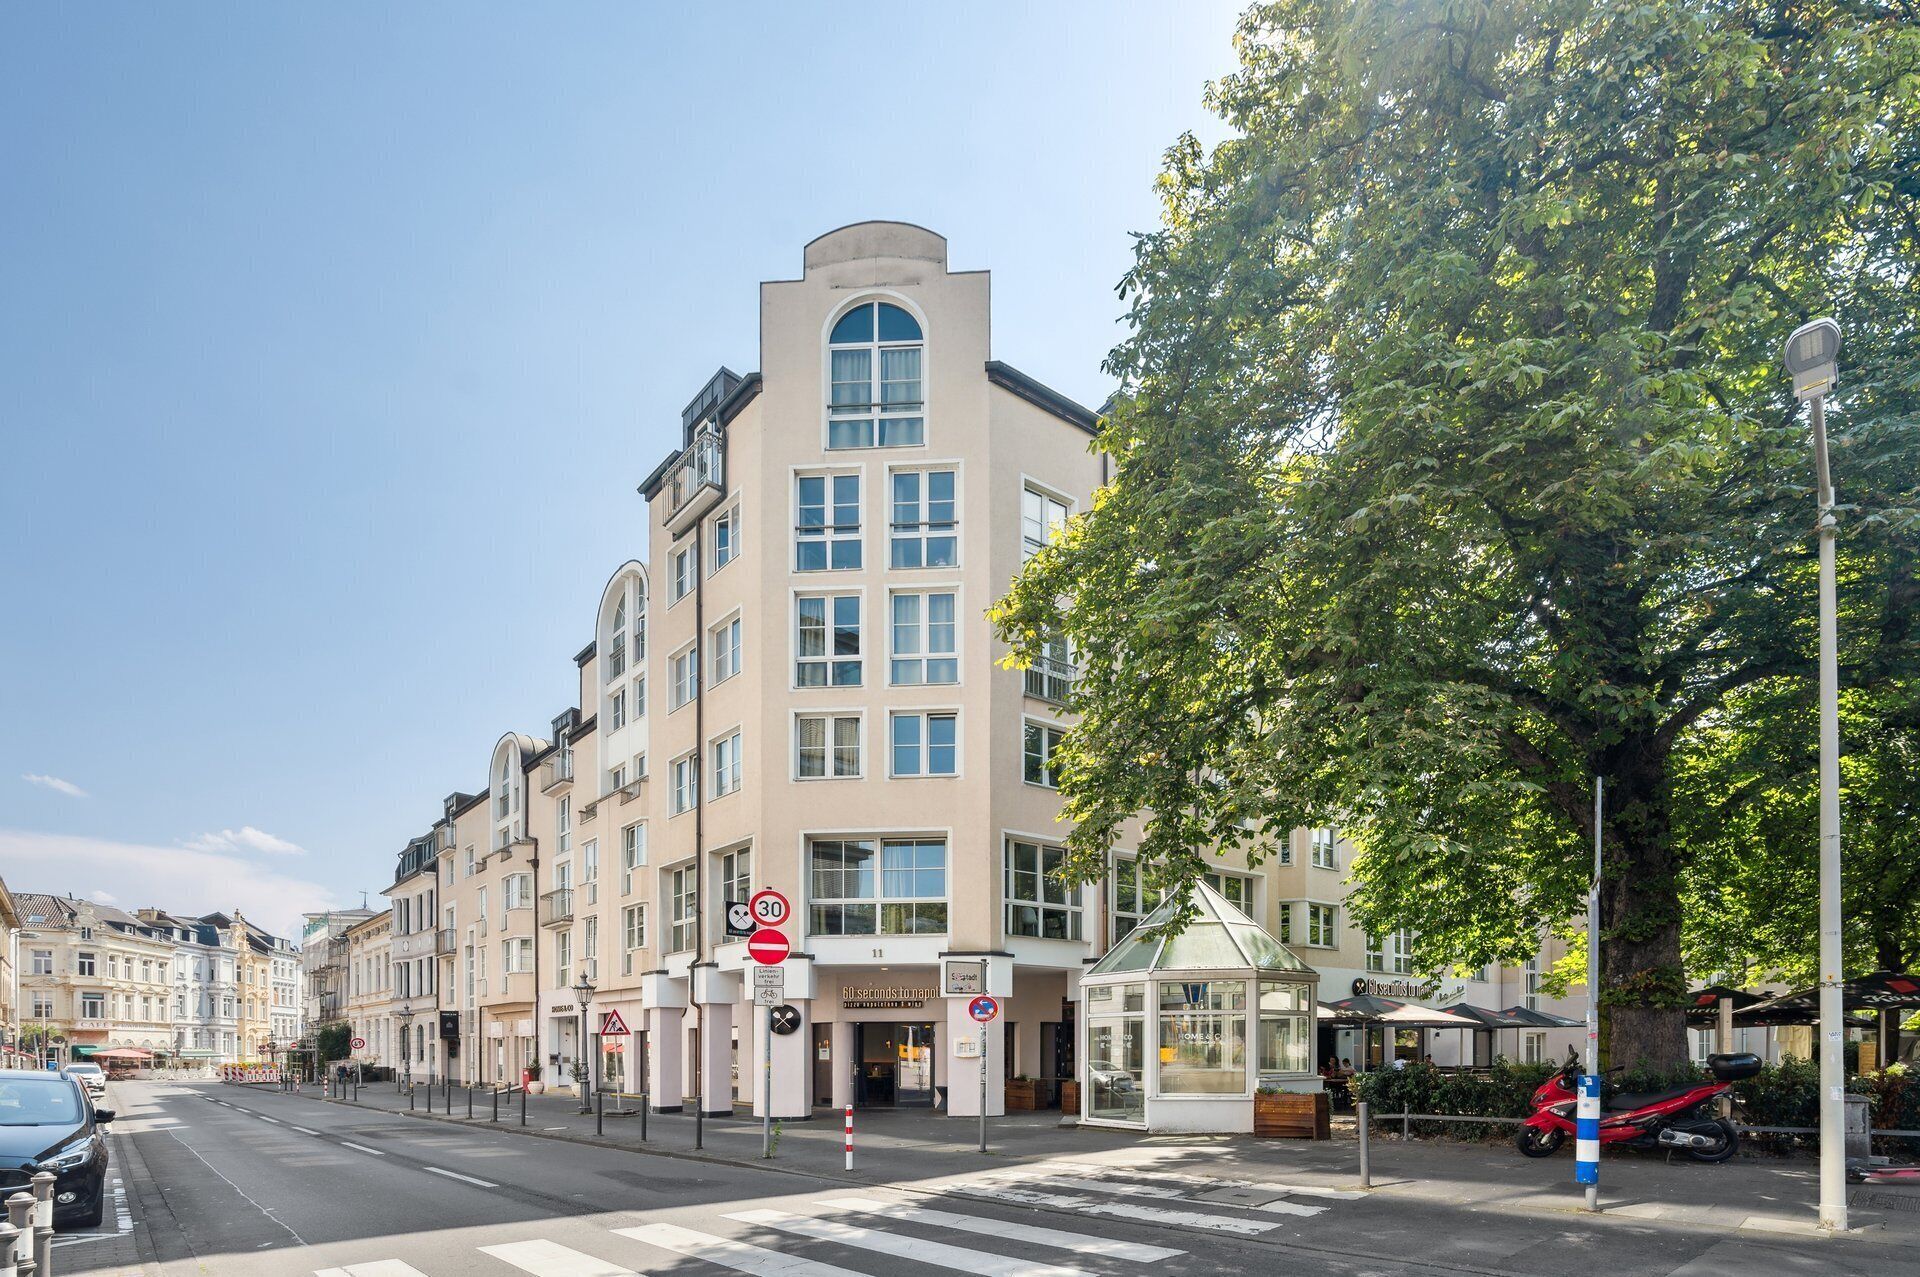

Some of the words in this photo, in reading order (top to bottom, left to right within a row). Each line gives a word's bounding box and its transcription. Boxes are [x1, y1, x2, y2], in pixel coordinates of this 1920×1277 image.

[759, 901, 782, 918] 30
[871, 948, 884, 958] 11
[842, 986, 854, 999] 60
[857, 986, 897, 999] seconds
[900, 986, 910, 999] to
[912, 985, 940, 1001] napol
